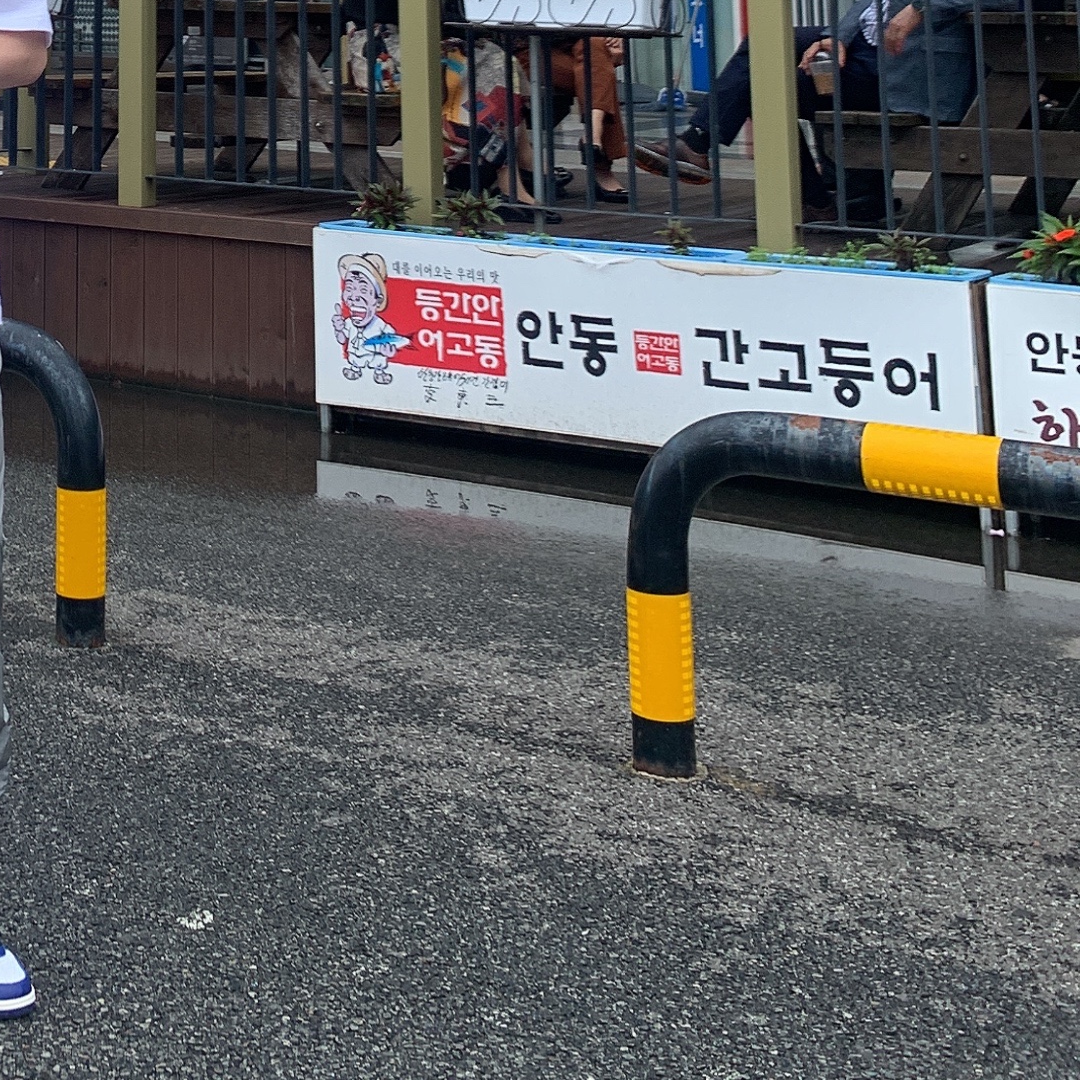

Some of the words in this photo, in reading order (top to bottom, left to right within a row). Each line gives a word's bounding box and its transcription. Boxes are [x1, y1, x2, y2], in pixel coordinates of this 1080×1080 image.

[414, 263, 452, 280] 이어오는
[456, 267, 485, 283] 우리의
[489, 270, 500, 284] 맛
[517, 310, 618, 377] 안동
[695, 328, 941, 412] 간고등어
